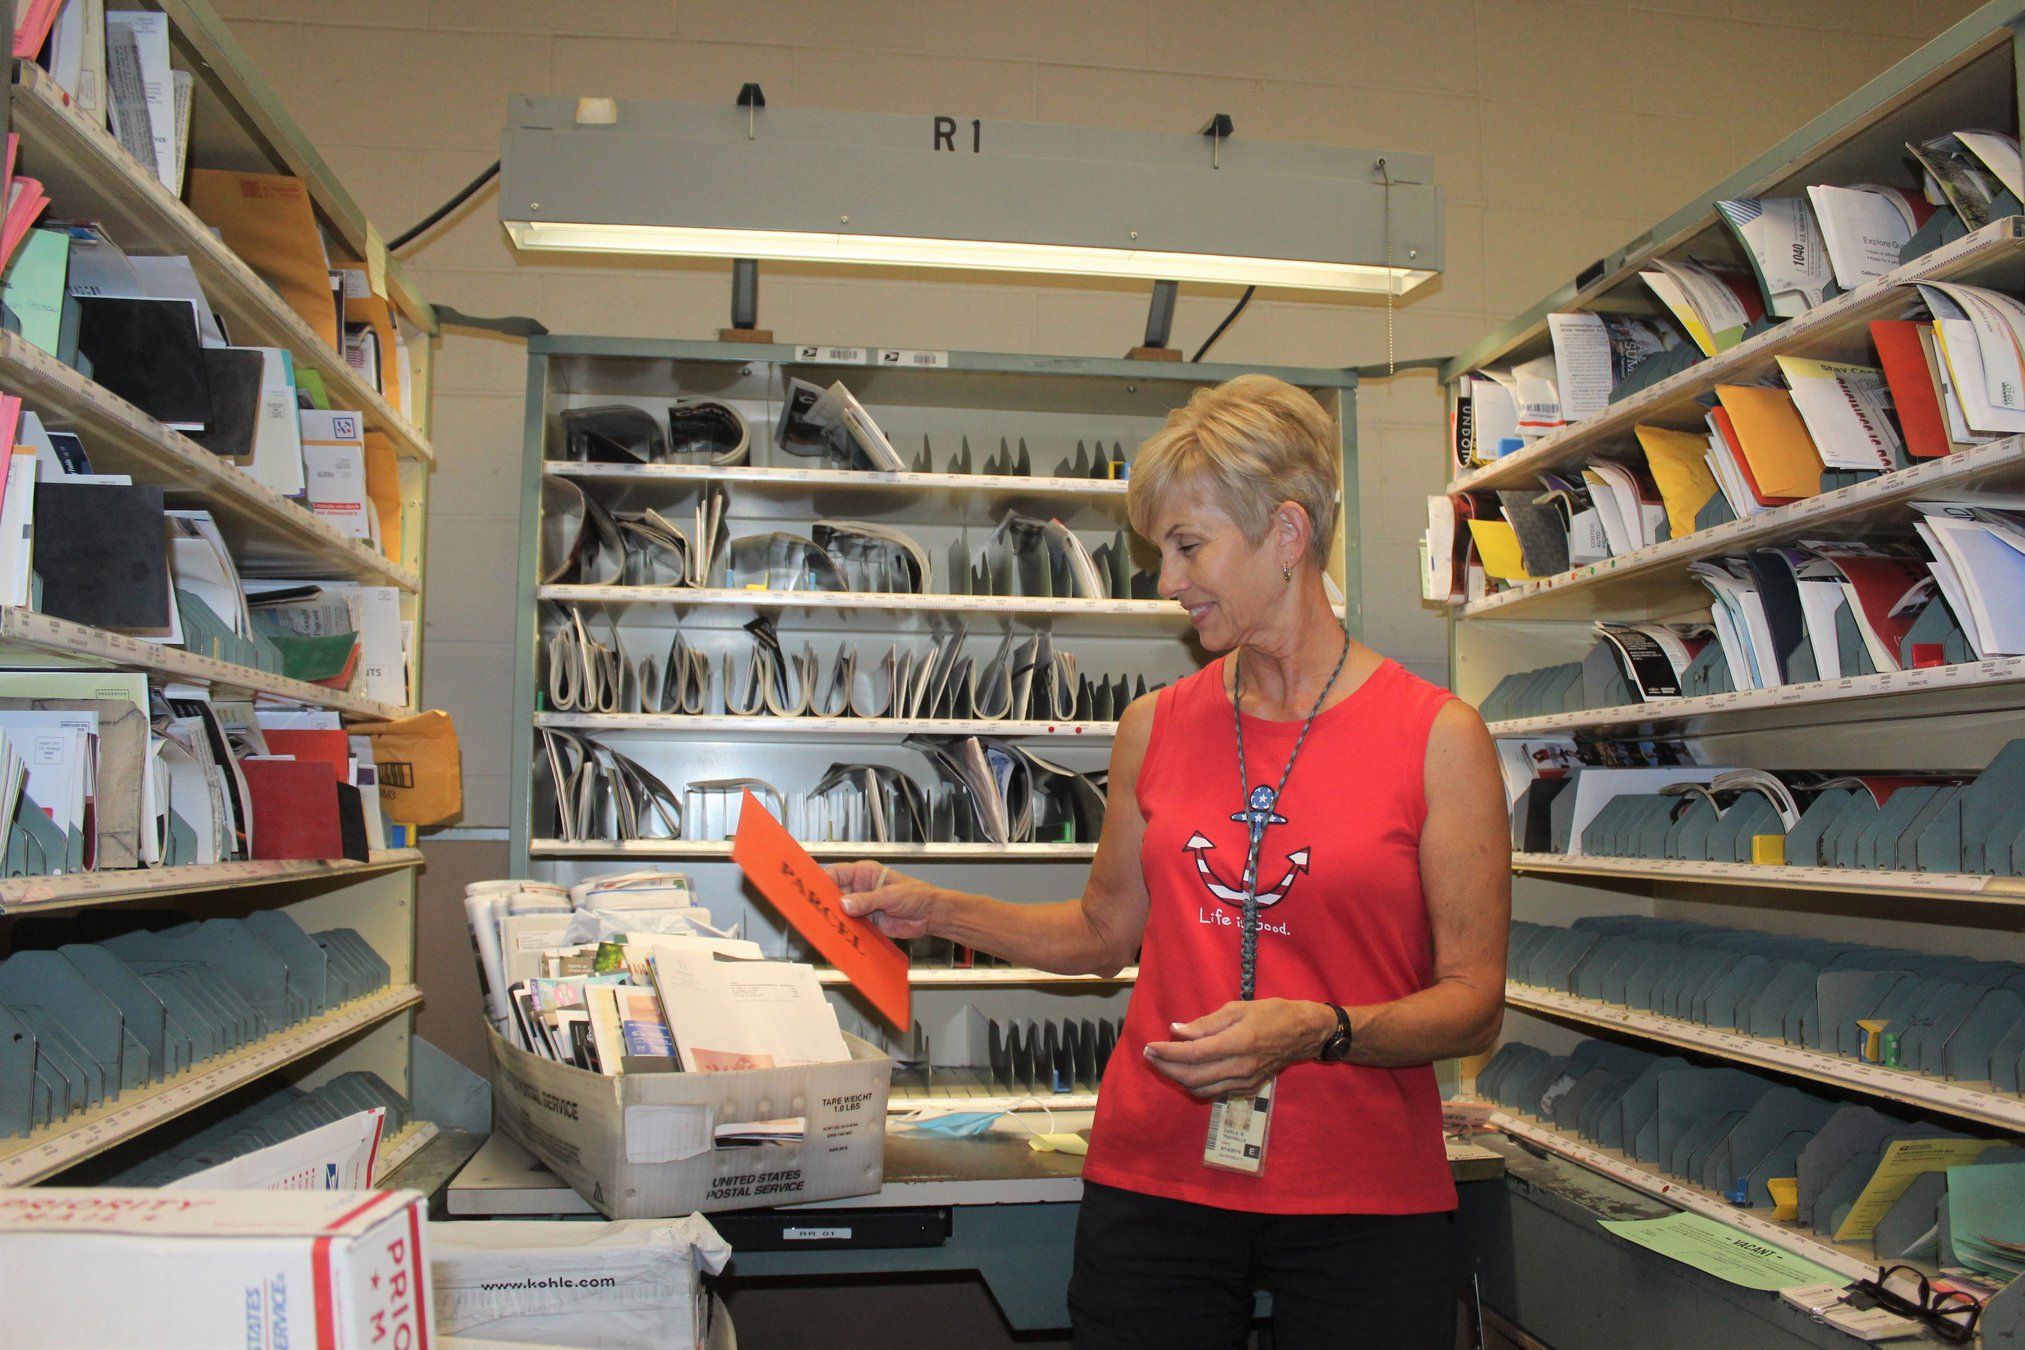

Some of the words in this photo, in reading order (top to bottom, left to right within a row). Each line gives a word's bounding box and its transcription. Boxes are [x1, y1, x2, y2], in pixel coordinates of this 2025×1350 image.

[934, 116, 957, 152] R
[972, 119, 980, 153] 1
[1862, 236, 1891, 248] Explore
[1792, 243, 1805, 267] 1040
[781, 861, 866, 957] PARCEL
[1199, 907, 1232, 926] Life
[822, 1097, 843, 1107] TARE
[844, 1092, 873, 1104] WEIGHT
[834, 1105, 844, 1113] 1.0
[845, 1103, 861, 1111] LBS
[1249, 1147, 1256, 1156] E
[712, 1173, 756, 1188] UNITED
[757, 1169, 802, 1184] STATES
[706, 1184, 752, 1201] POSTAL
[754, 1180, 805, 1196] SERVICE
[1733, 1238, 1777, 1260] VACANT
[386, 1237, 411, 1350] PRIO
